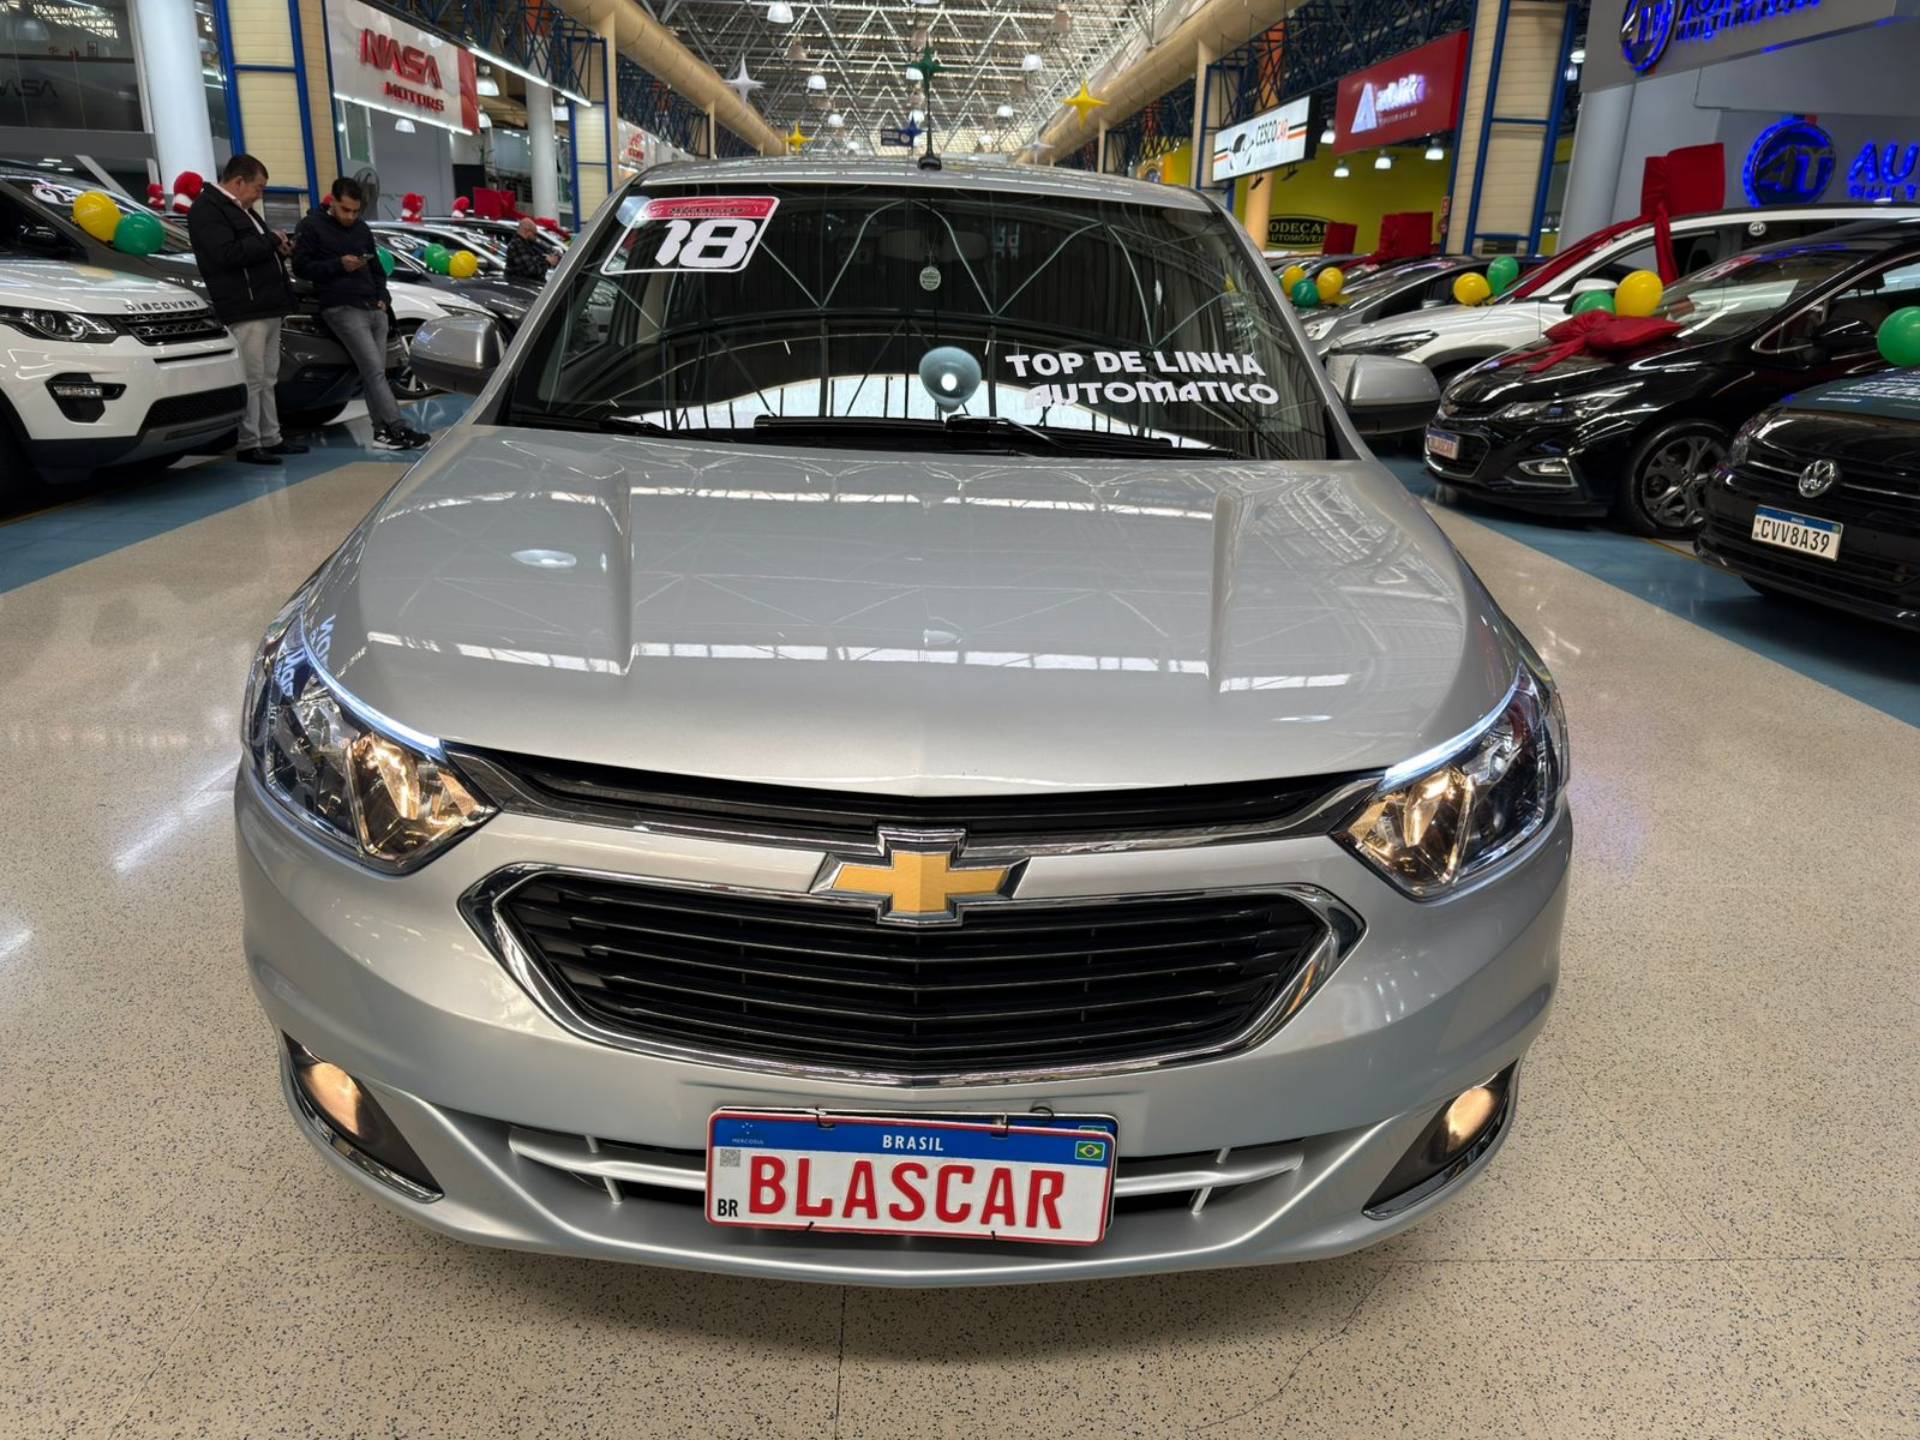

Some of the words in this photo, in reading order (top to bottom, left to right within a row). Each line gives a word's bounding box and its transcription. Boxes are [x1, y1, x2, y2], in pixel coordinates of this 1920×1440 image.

[360, 28, 442, 89] NASA
[0, 79, 58, 97] ASA
[383, 81, 444, 112] MOTORS
[1269, 222, 1328, 234] ODECA
[654, 219, 757, 268] 18
[124, 300, 200, 312] DISCOVERY
[1005, 352, 1084, 377] TOP
[1093, 351, 1147, 373] DE
[1153, 351, 1266, 376] LINHA
[1025, 381, 1279, 409] AUTOMATICO
[1761, 519, 1830, 553] CVV8A39
[882, 1134, 944, 1152] BRASIL
[748, 1155, 1065, 1230] BLASCAR
[717, 1199, 738, 1218] BR
